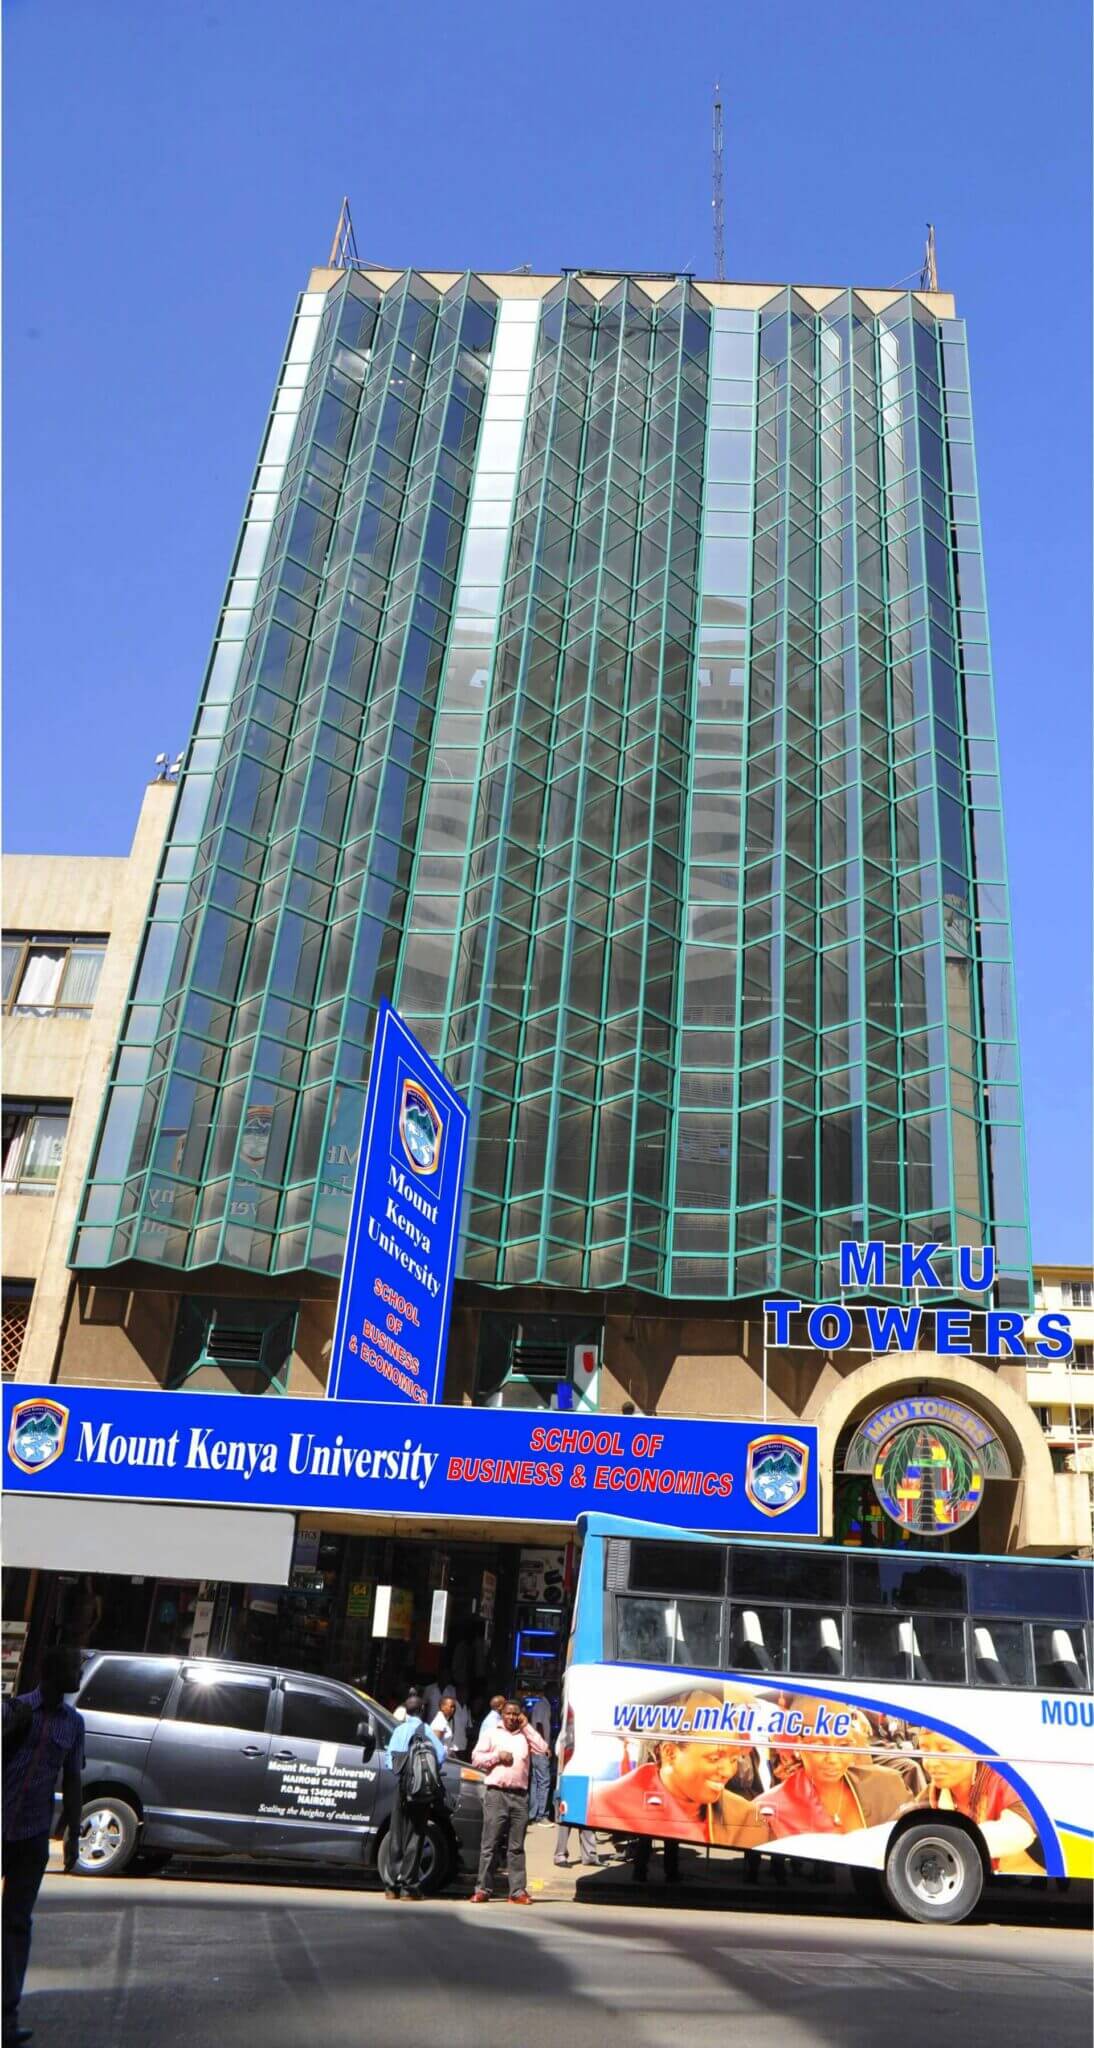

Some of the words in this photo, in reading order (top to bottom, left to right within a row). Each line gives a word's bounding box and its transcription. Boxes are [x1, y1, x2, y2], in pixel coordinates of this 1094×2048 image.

[387, 1164, 439, 1224] Mount
[385, 1197, 431, 1254] Kenya
[368, 1215, 441, 1297] University
[840, 1240, 995, 1292] MKU
[373, 1278, 420, 1327] SCHOOL
[386, 1313, 403, 1335] OF
[362, 1319, 419, 1376] BUSINESS
[763, 1300, 1074, 1358] TOWERS
[348, 1335, 358, 1355] &
[360, 1343, 428, 1405] ECONOMICS
[529, 1428, 624, 1455] SCHOOL
[631, 1434, 664, 1458] OF
[868, 1403, 909, 1439] MKU
[911, 1401, 987, 1441] TOWERS
[75, 1421, 179, 1468] Mount
[184, 1428, 277, 1479] Kenya
[288, 1432, 439, 1490] University
[446, 1457, 563, 1486] BUSINESS
[569, 1464, 587, 1488] &
[593, 1466, 734, 1498] ECONOMICS
[612, 1702, 852, 1737] www.mku.ac.ke
[268, 1761, 297, 1772] Mount
[298, 1764, 327, 1776] Kenya
[329, 1767, 376, 1781] University
[283, 1775, 320, 1785] NAIROBI
[322, 1778, 358, 1789] CENTRE
[258, 1803, 286, 1816] Scaling
[287, 1806, 299, 1816] the
[299, 1807, 325, 1819] heights
[326, 1811, 336, 1820] of
[335, 1812, 370, 1821] education
